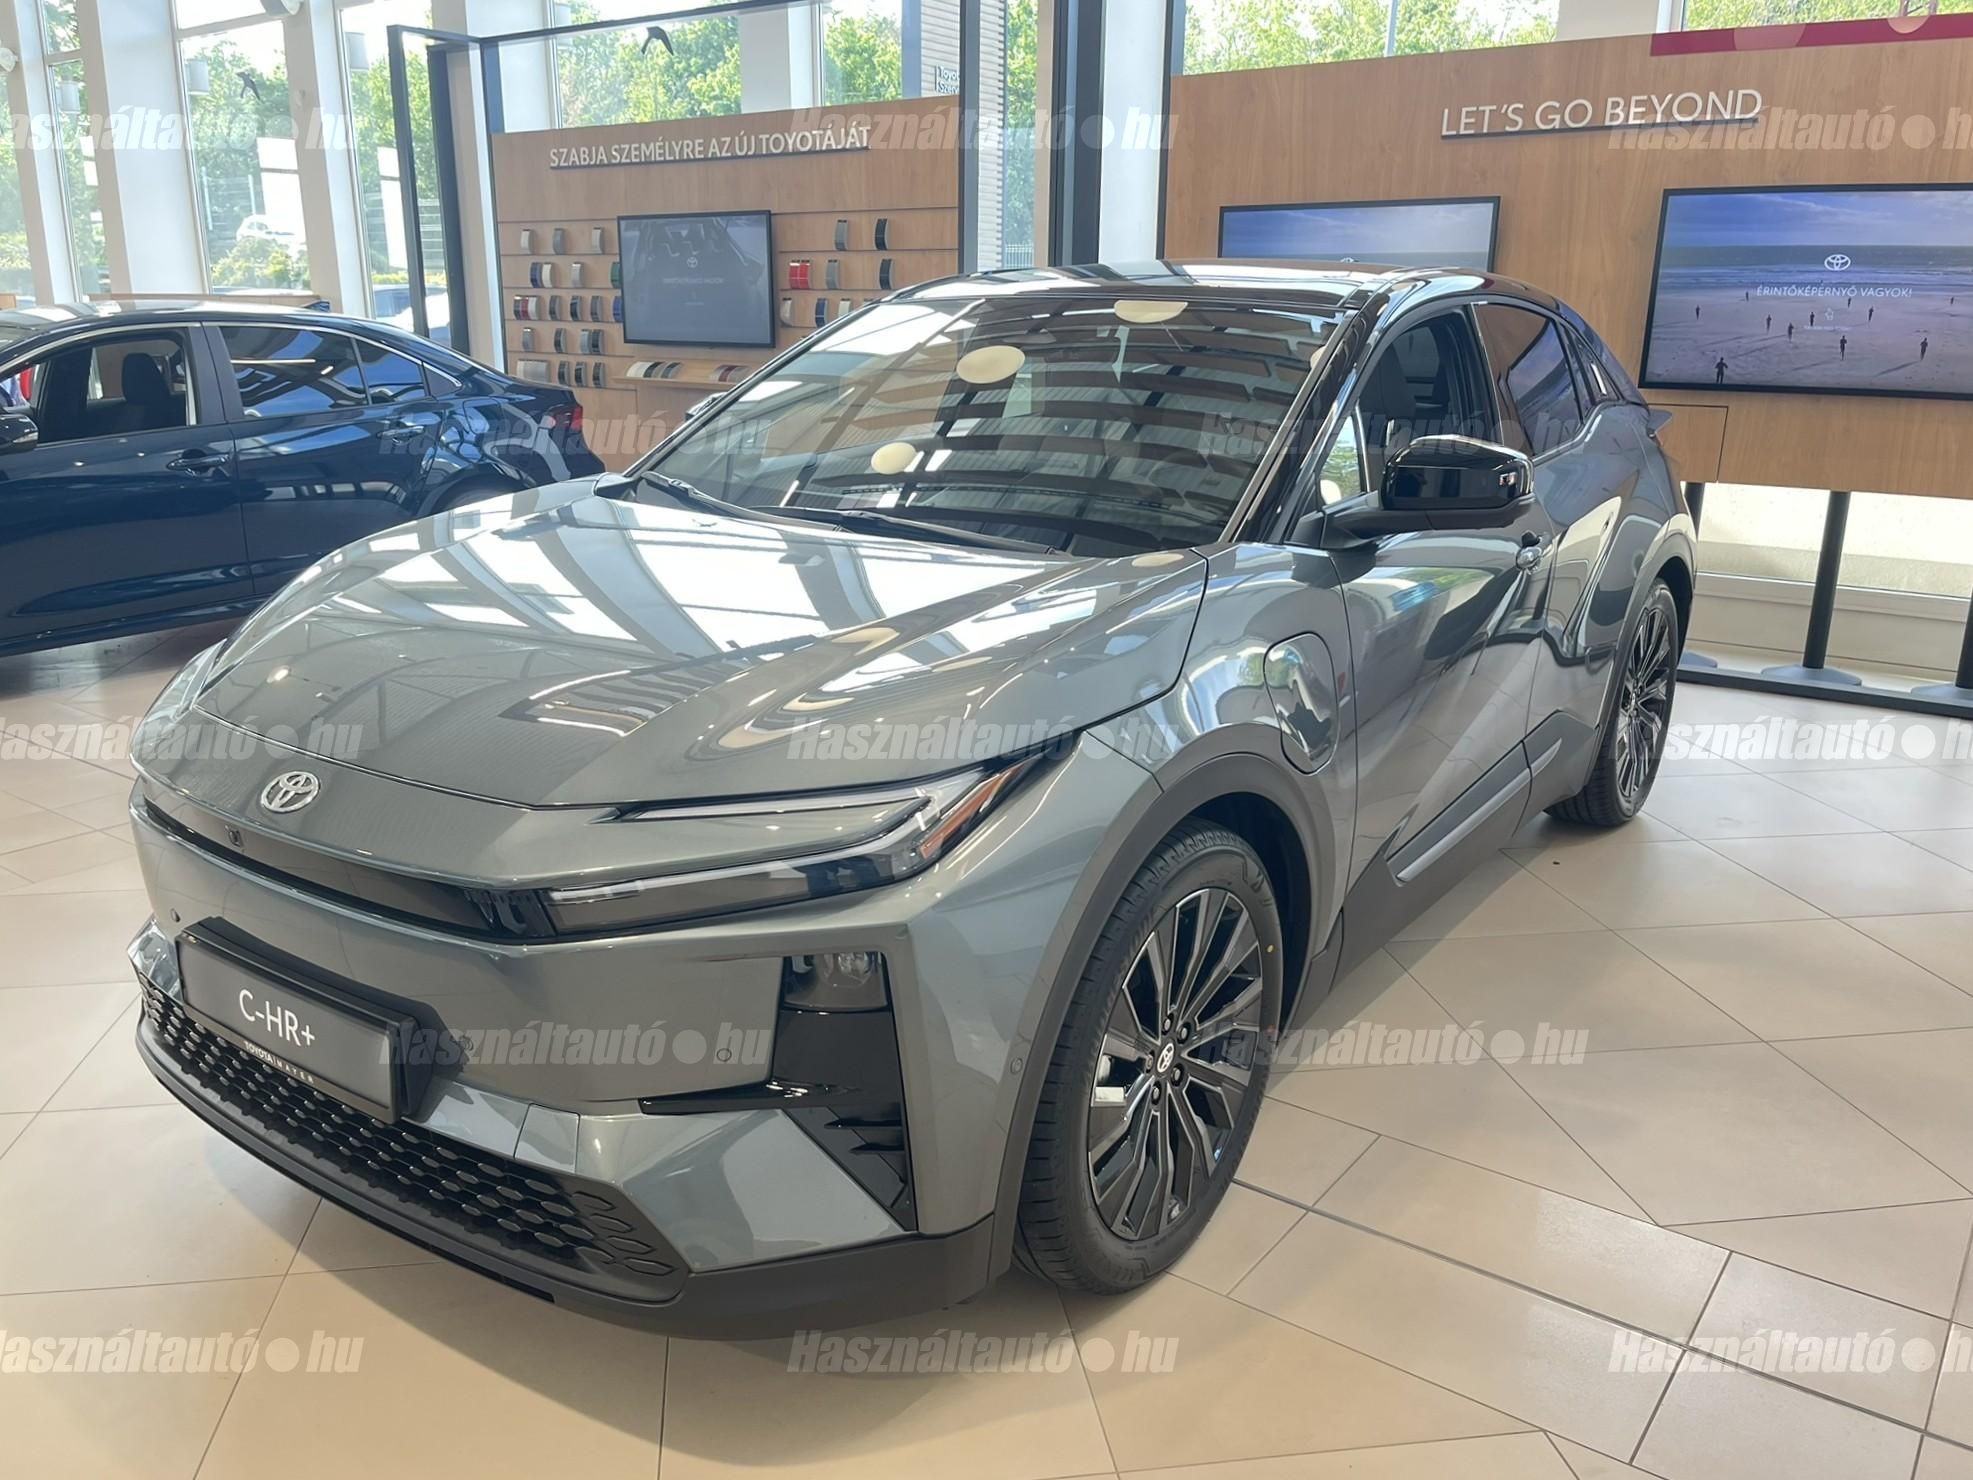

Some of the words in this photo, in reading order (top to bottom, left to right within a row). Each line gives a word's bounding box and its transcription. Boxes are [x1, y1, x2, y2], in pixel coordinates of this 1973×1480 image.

[1441, 101, 1524, 136] LET'S
[1534, 98, 1593, 130] GO
[1604, 88, 1762, 126] BEYOND
[550, 145, 608, 168] SZABJA
[611, 136, 705, 164] SZEMÉLYRE
[708, 136, 732, 158] AZ
[735, 130, 756, 155] ÚJ
[759, 121, 871, 154] TOYOTÁJÁT
[239, 989, 315, 1046] C-HR+
